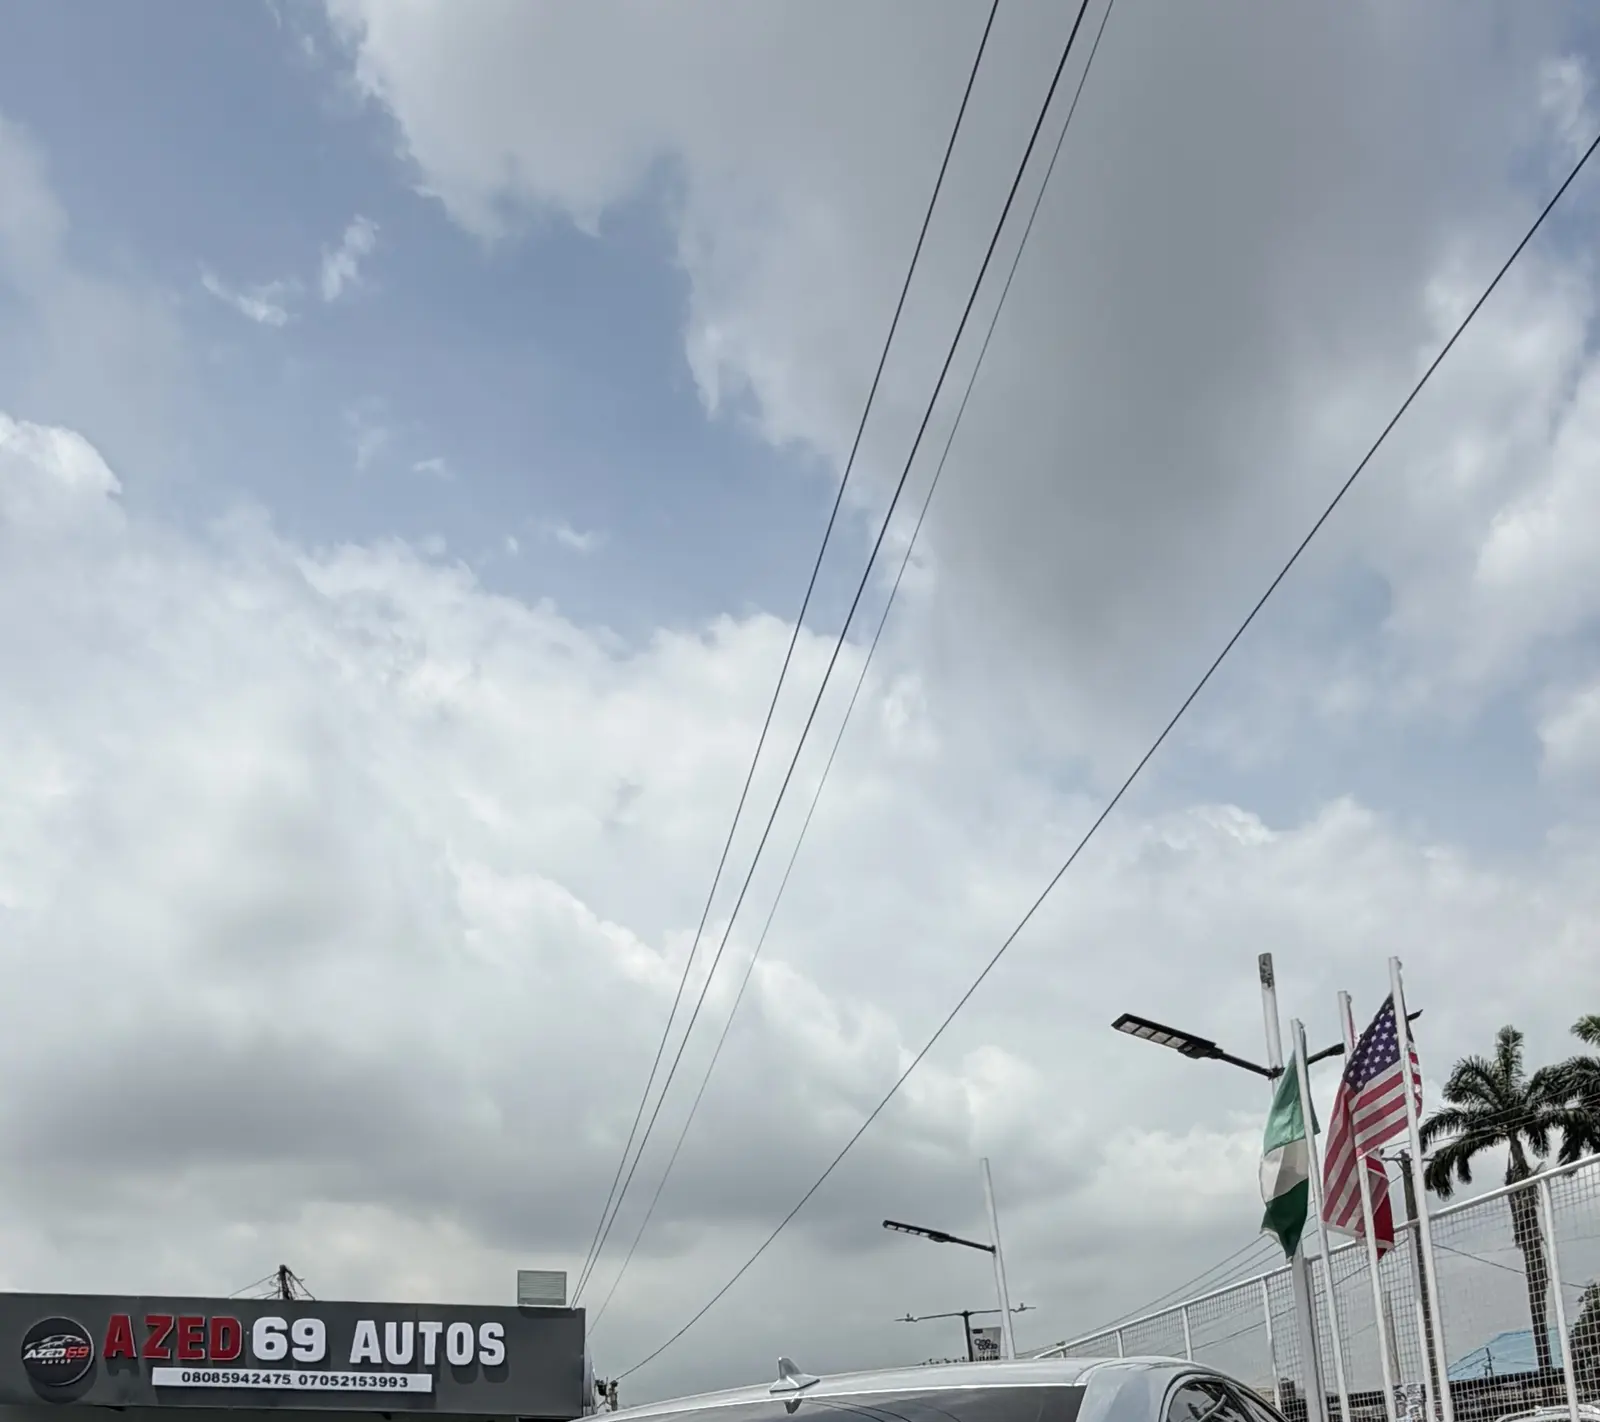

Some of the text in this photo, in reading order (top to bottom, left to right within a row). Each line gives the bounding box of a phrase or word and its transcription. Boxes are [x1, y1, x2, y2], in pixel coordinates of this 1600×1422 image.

[103, 1314, 505, 1366] AZED 69 AUTOS
[181, 1371, 409, 1388] 08085942475 07052153993
